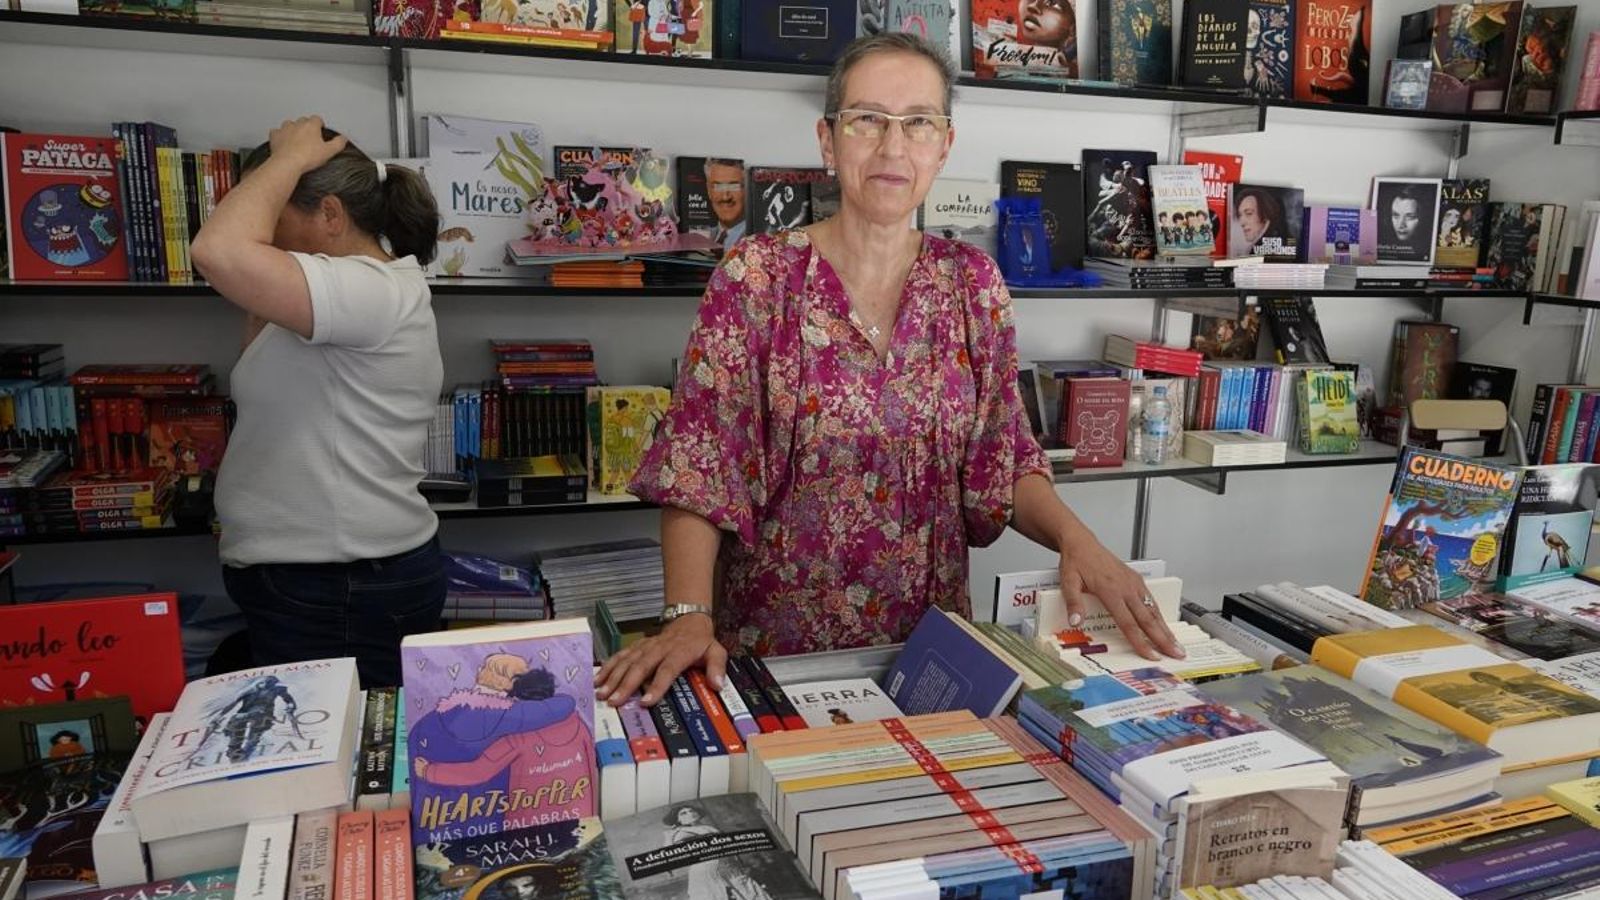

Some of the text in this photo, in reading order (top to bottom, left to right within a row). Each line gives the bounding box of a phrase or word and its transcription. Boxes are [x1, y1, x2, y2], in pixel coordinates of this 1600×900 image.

[1198, 13, 1215, 23] LOS
[1198, 22, 1237, 32] DIARIOS
[1197, 33, 1225, 41] DE LA
[986, 38, 1057, 67] Freedom!
[1304, 45, 1349, 71] LOBOS
[44, 139, 86, 153] Super
[22, 149, 113, 169] PATACA
[452, 182, 523, 214] Mares
[936, 203, 991, 214] COMPAÑERA
[958, 193, 970, 203] LA
[1262, 236, 1282, 247] SUSO
[1316, 376, 1350, 401] HEIDI
[1409, 454, 1516, 490] CUADERNO
[77, 621, 120, 652] leo
[206, 668, 264, 685] SARAH
[281, 662, 332, 673] MAAS
[792, 688, 879, 705] IERRA
[155, 738, 323, 778] CRISTAL
[529, 760, 571, 775] volumen
[419, 776, 589, 830] HEARTSTOPPER
[430, 808, 580, 843] MÁS QUE PALABRAS
[1210, 826, 1289, 848] Retratos en
[297, 842, 313, 871] FUNKE
[313, 827, 329, 870] CORNELIA
[466, 835, 540, 857] SARAH
[632, 857, 642, 866] A
[645, 840, 708, 863] defunción
[710, 836, 732, 846] dos
[734, 831, 766, 841] sexos
[1208, 840, 1312, 864] branco e negro
[480, 847, 548, 870] MAAS
[104, 879, 198, 900] CASA
